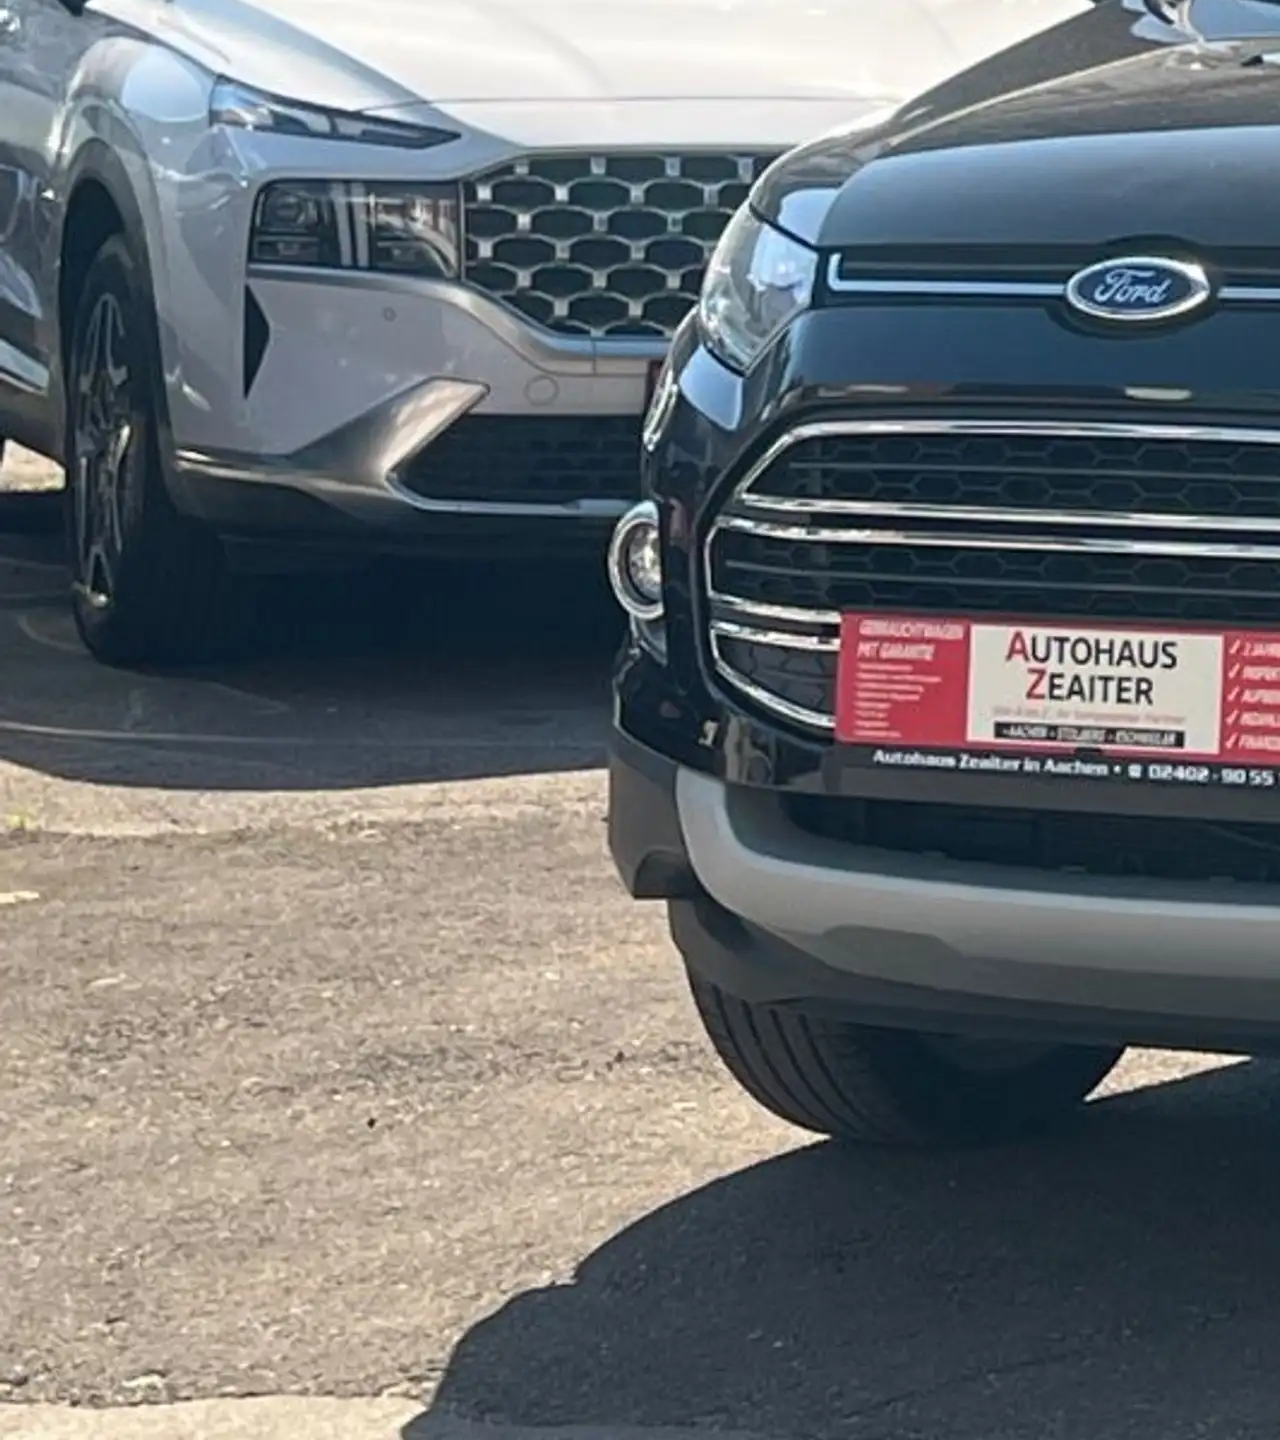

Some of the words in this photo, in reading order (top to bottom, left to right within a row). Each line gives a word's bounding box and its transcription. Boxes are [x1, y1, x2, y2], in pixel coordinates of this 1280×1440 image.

[1093, 267, 1172, 304] Ford
[1005, 630, 1178, 670] AUTOHAUS
[1025, 667, 1154, 706] ZEAITER
